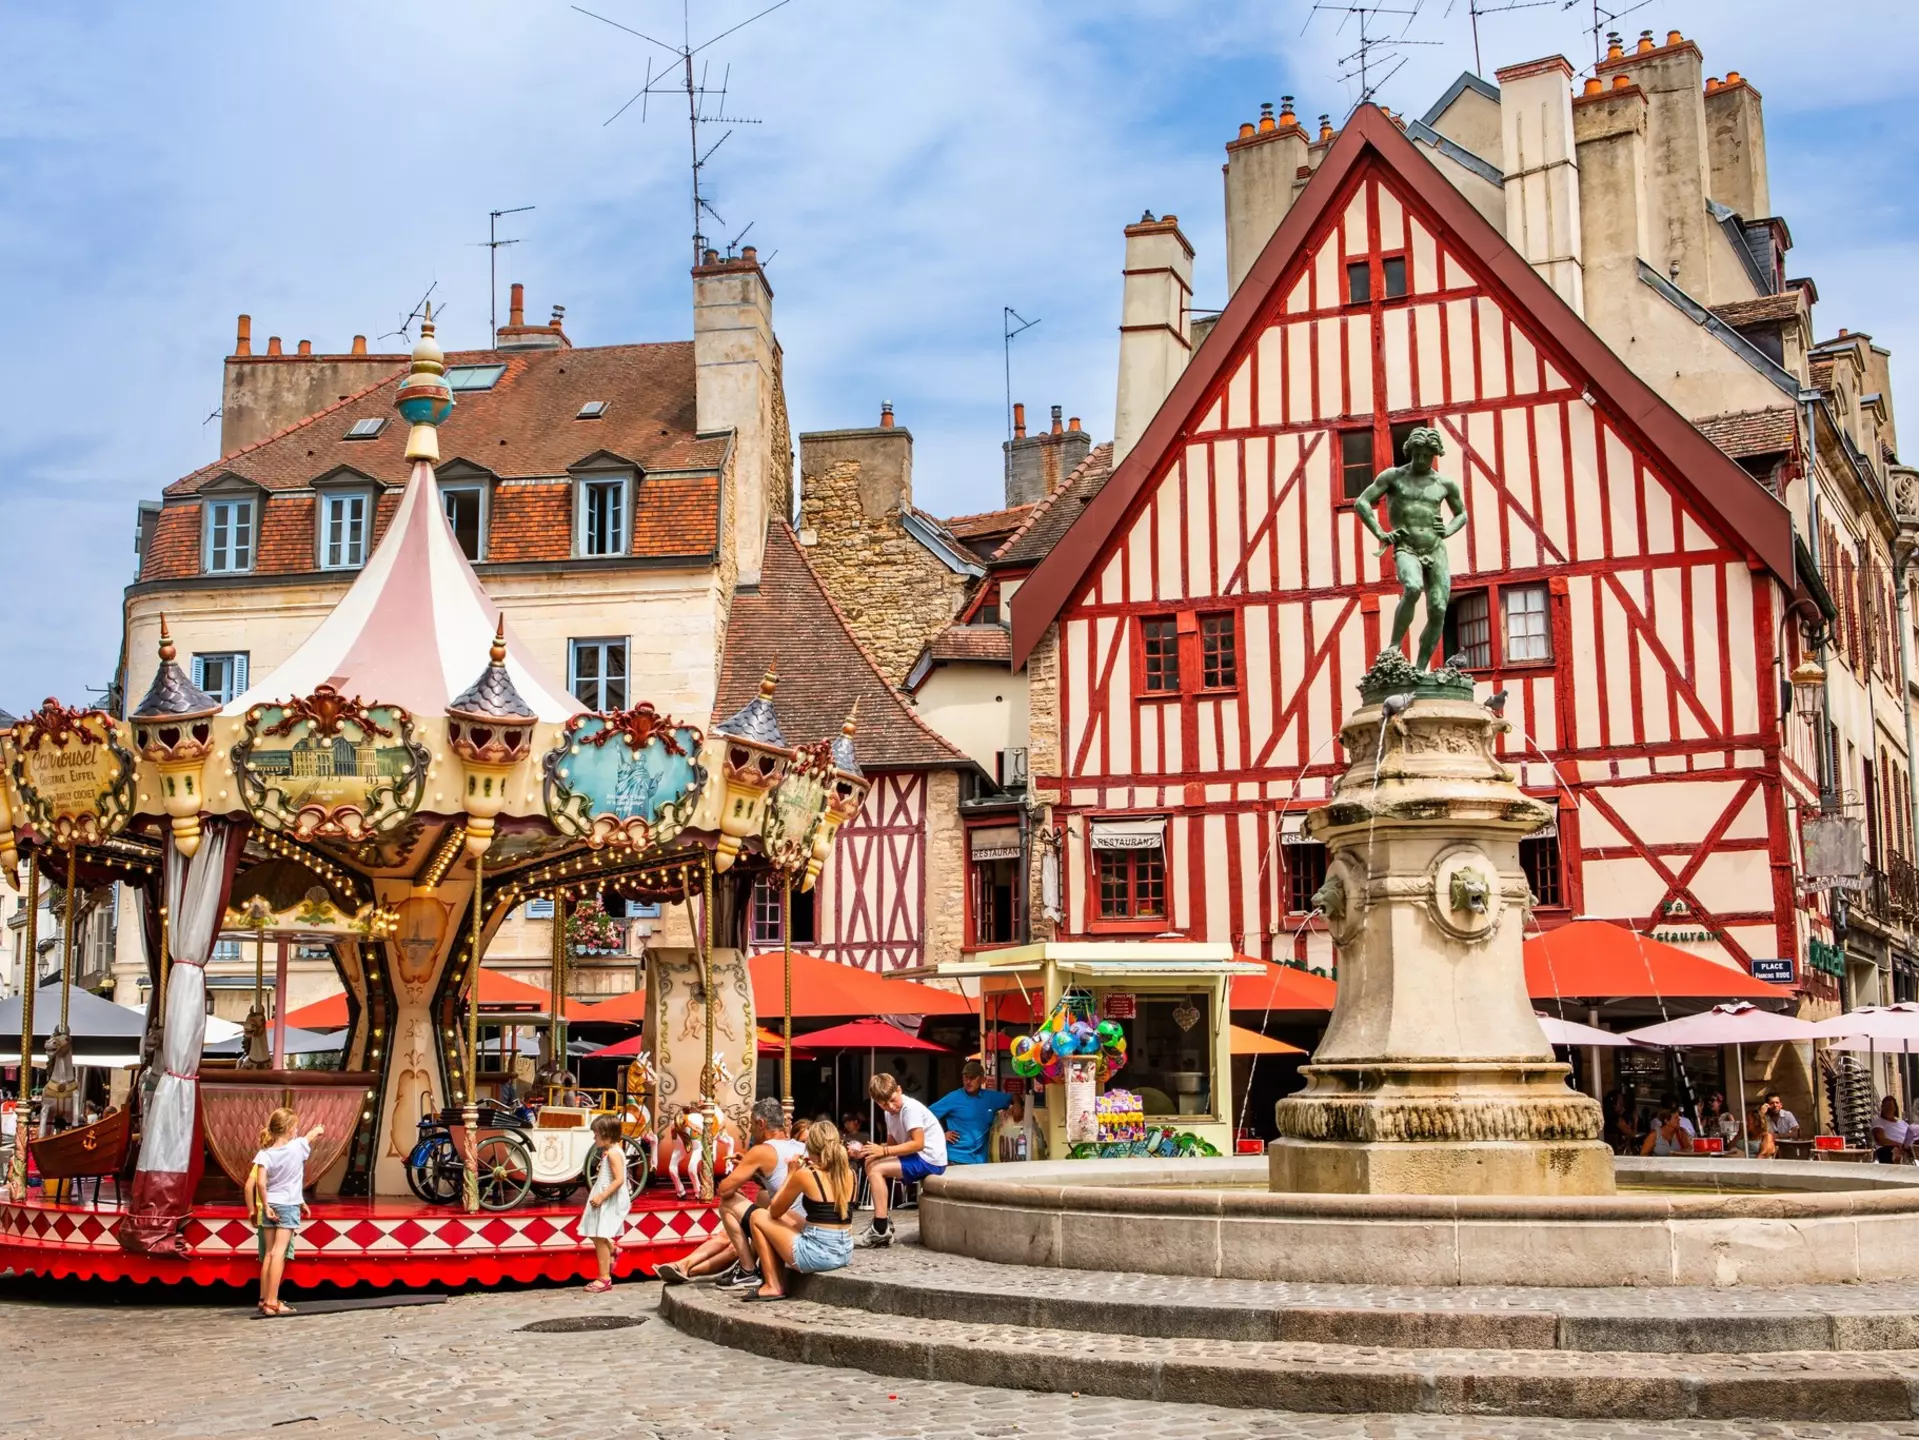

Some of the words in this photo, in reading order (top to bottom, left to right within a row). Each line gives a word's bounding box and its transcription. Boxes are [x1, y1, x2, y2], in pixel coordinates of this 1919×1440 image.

[1097, 837, 1154, 847] RESTAURANT
[973, 847, 1019, 858] RESTAURAN
[1811, 876, 1861, 892] RESTAURANT
